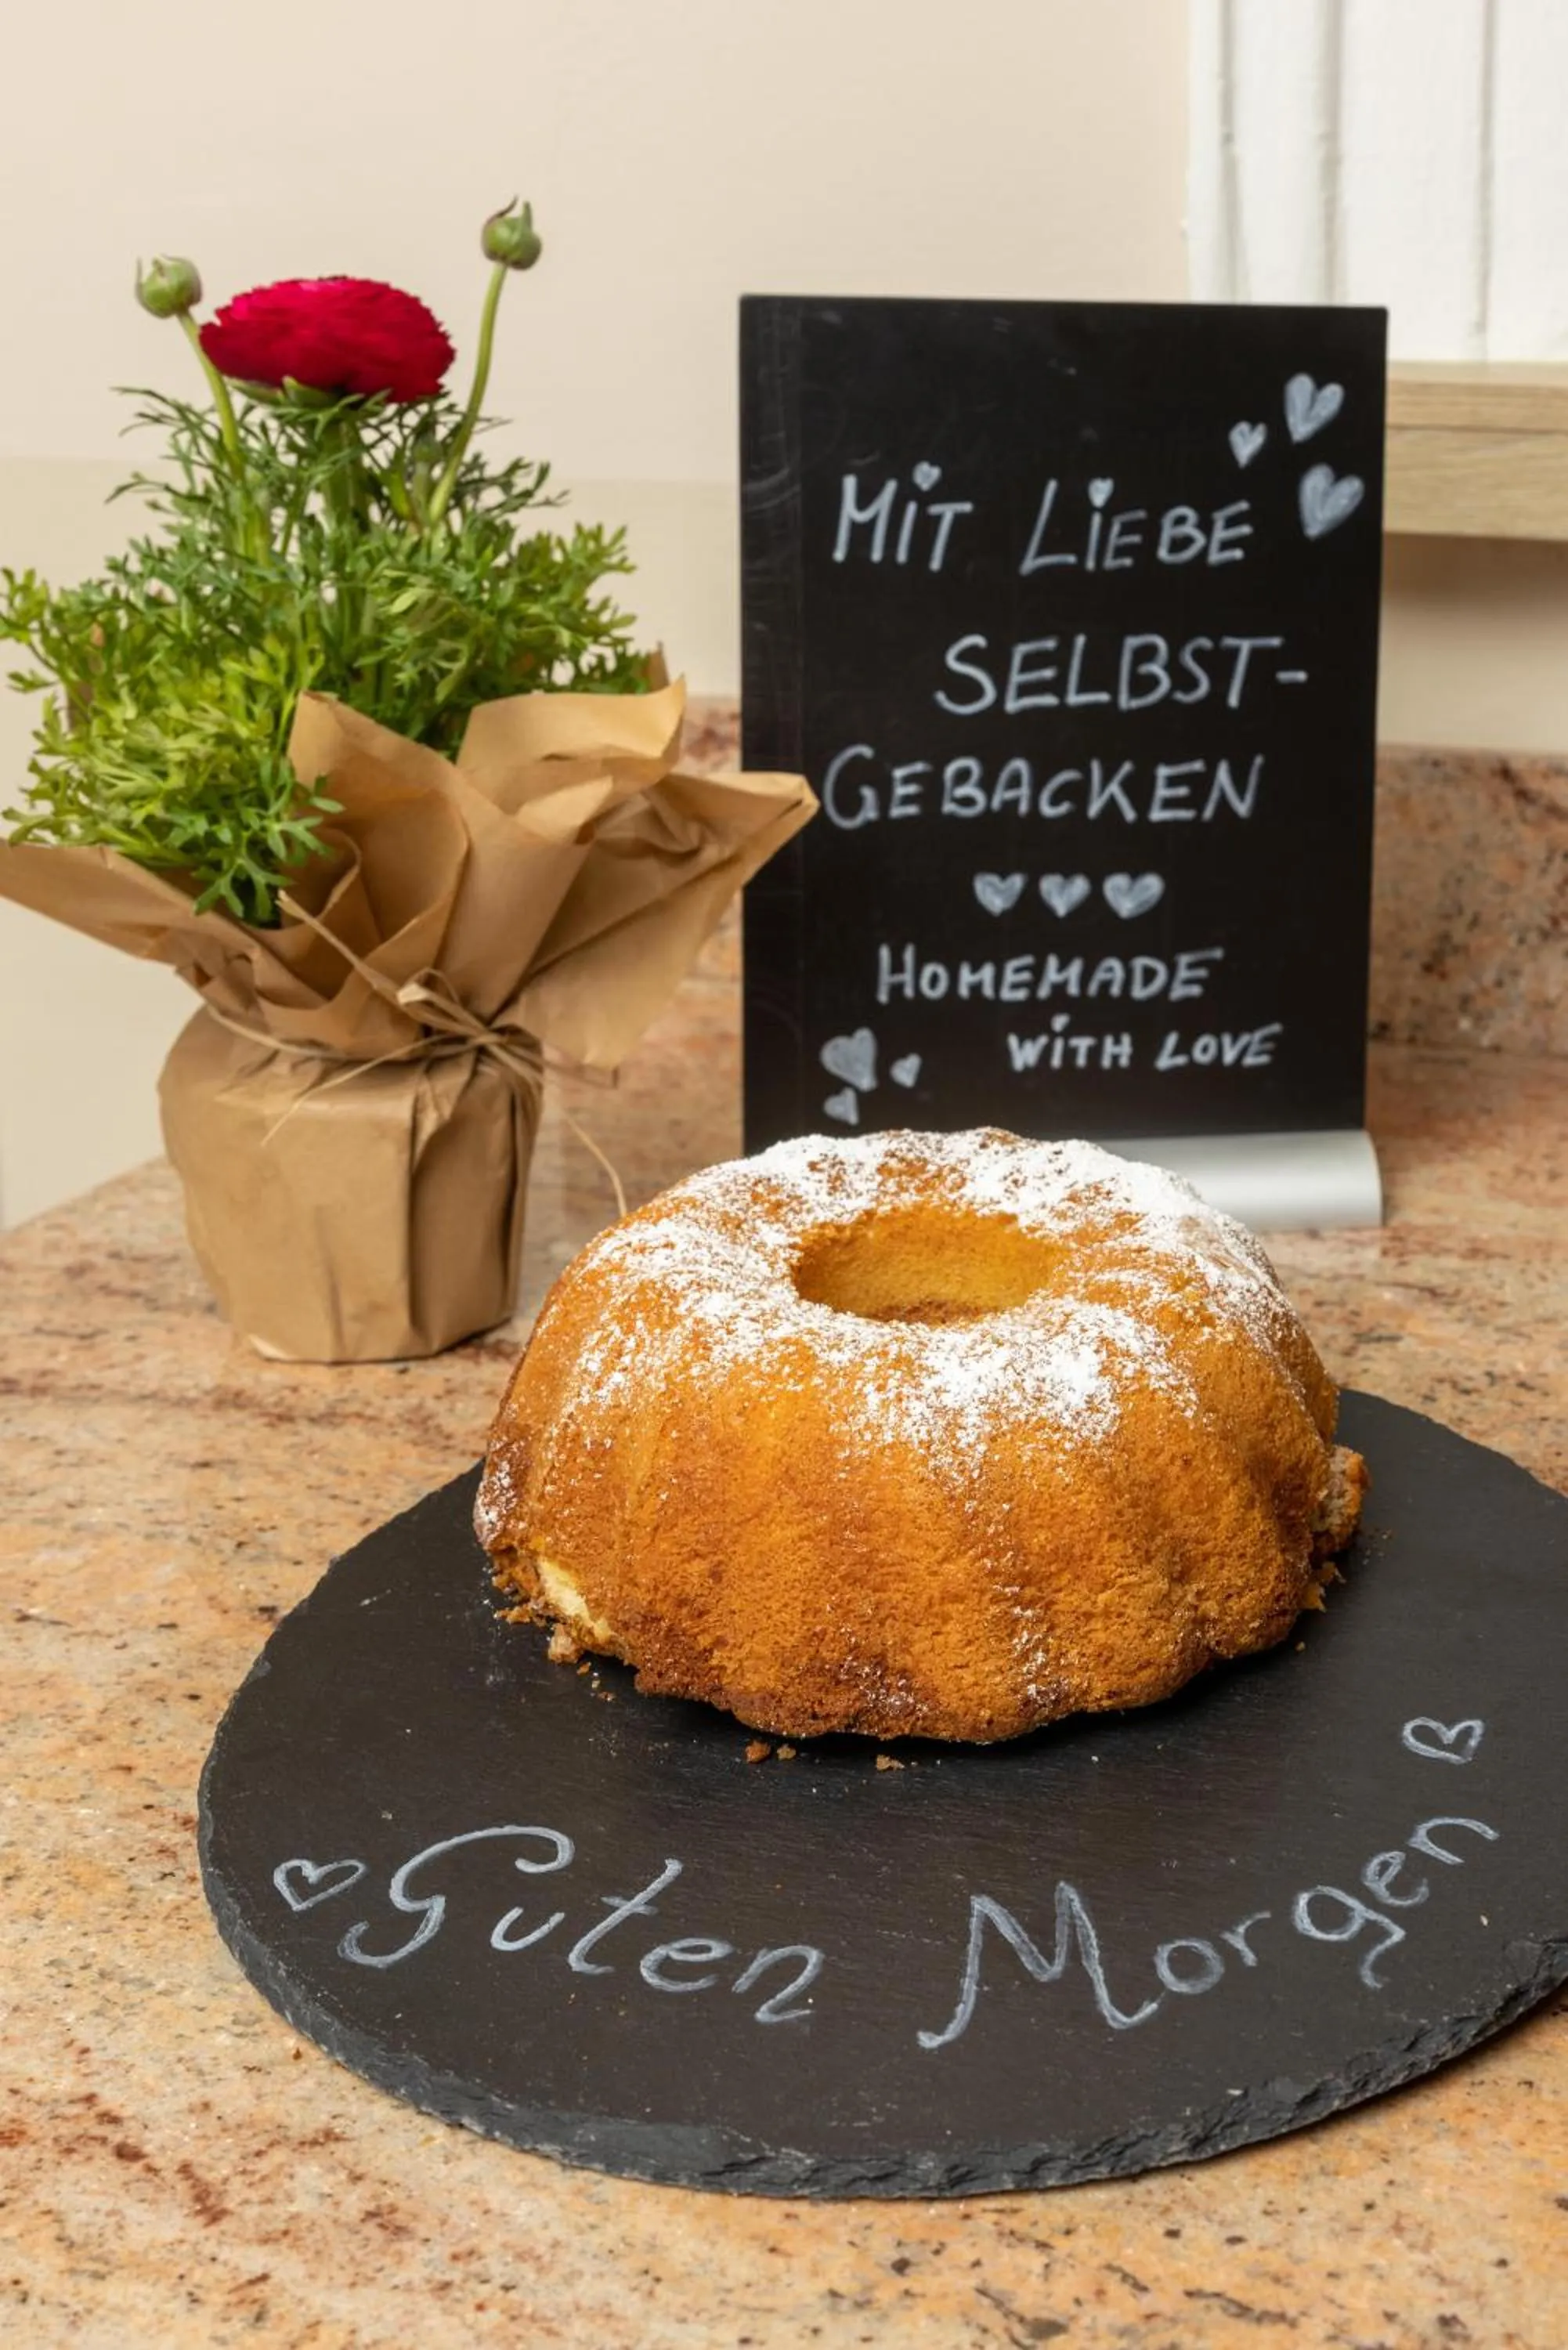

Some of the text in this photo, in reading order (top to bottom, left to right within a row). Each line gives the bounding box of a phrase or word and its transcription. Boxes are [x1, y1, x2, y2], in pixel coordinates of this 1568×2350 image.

[935, 634, 1308, 714] SELBST-
[824, 745, 1264, 829] GEBACKEN
[1155, 1023, 1283, 1070] LOVE
[338, 1817, 1500, 2049] Guten Morgen
